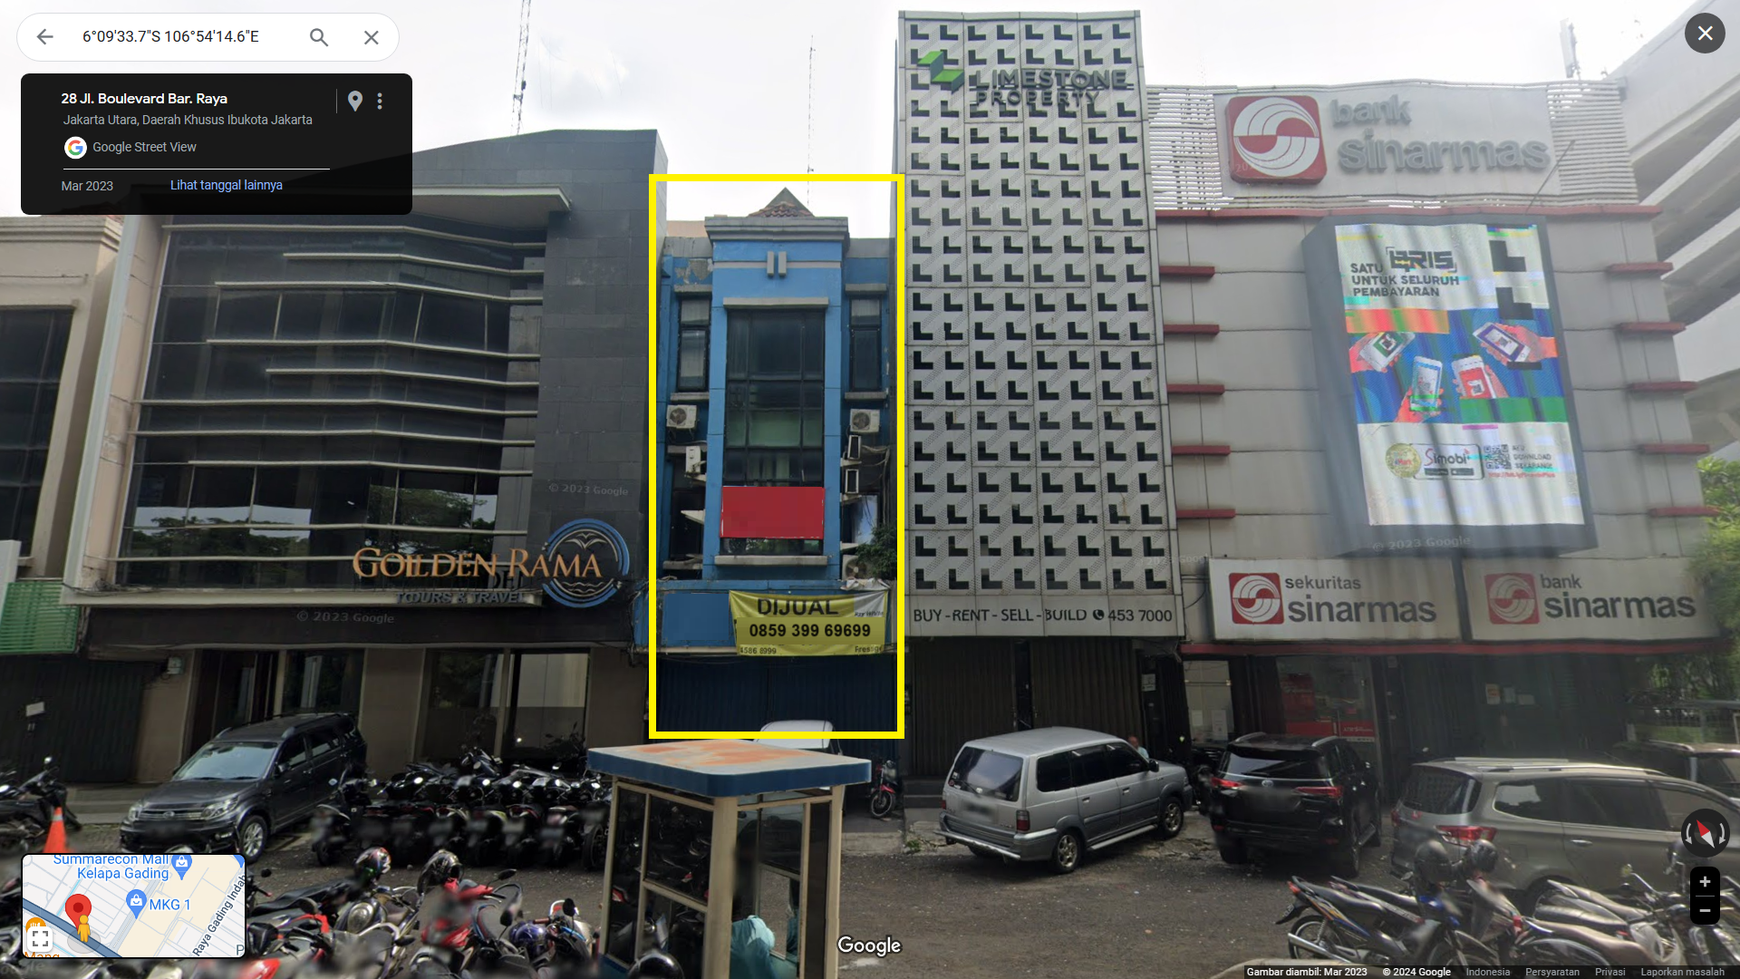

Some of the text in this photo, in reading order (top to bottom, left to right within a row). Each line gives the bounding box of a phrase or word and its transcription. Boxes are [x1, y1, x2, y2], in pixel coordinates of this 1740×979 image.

[975, 69, 1128, 90] LIMESTONE
[975, 91, 1100, 107] PROPERTY
[1331, 94, 1413, 127] bank
[1337, 128, 1550, 173] sinarmas
[1350, 262, 1384, 274] SATU
[1351, 275, 1460, 286] UNTUK SELURUH
[1353, 287, 1440, 297] PEMBAYARAN
[508, 547, 603, 578] RAMA
[1284, 575, 1362, 590] sekuritas
[1540, 574, 1582, 589] bank
[472, 591, 526, 604] TRAVEL
[1544, 591, 1697, 619] sinarmas
[757, 598, 839, 616] DIJUAL
[1288, 594, 1437, 623] sinarmas
[913, 609, 942, 622] BUY
[952, 609, 990, 622] RENT
[1001, 609, 1034, 622] SELL
[1045, 609, 1087, 622] BUILD
[1108, 609, 1135, 622] 453
[1140, 609, 1172, 622] 7000
[749, 623, 871, 637] 0859 399 69699
